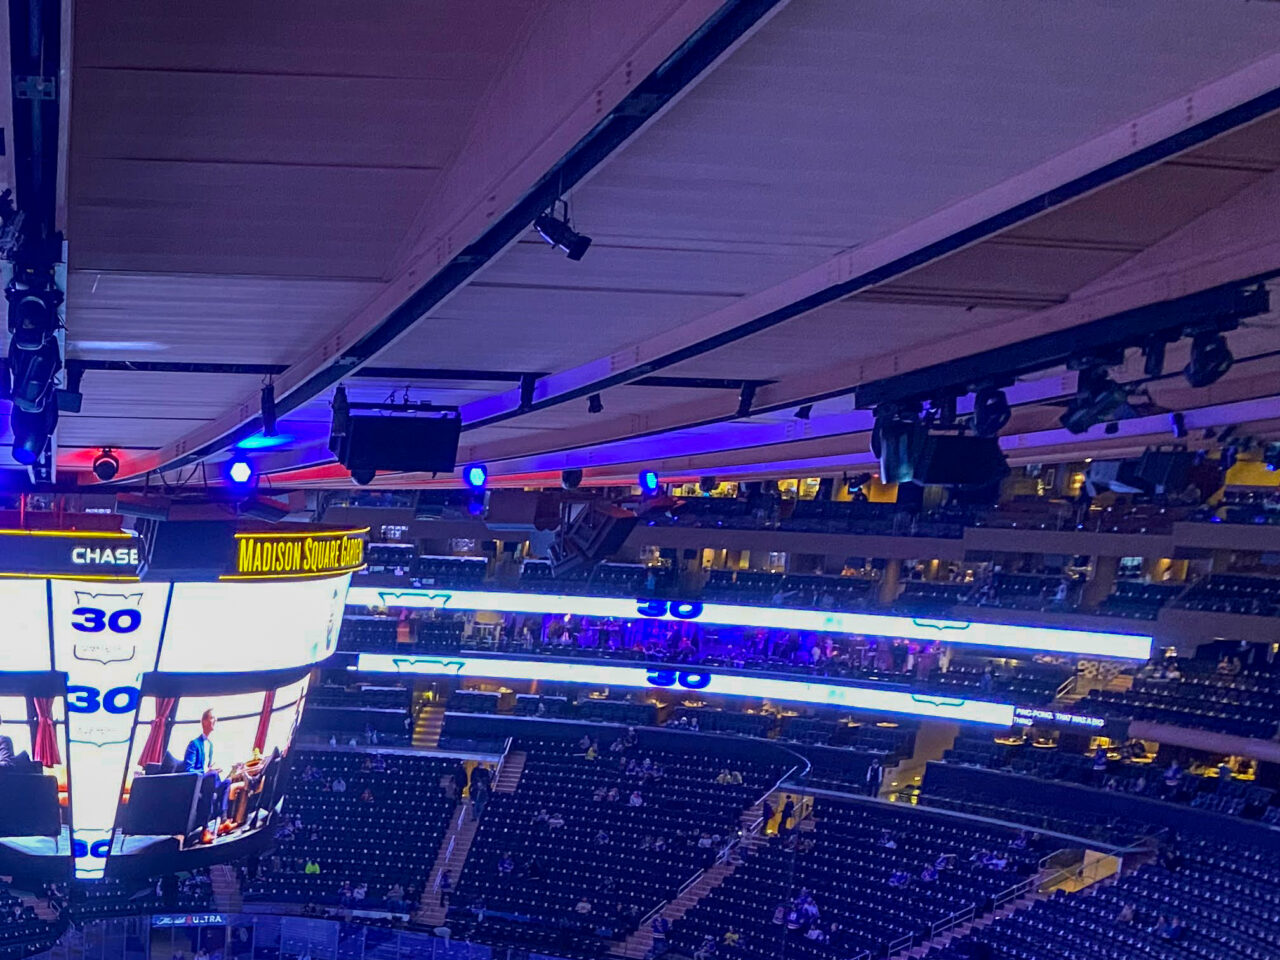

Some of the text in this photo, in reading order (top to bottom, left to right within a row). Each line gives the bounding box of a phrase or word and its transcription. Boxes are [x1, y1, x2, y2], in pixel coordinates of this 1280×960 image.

[71, 547, 139, 565] CHASE
[239, 538, 302, 573] MADISON
[303, 537, 341, 572] SQUARE
[71, 606, 142, 634] 30
[67, 685, 141, 715] 30
